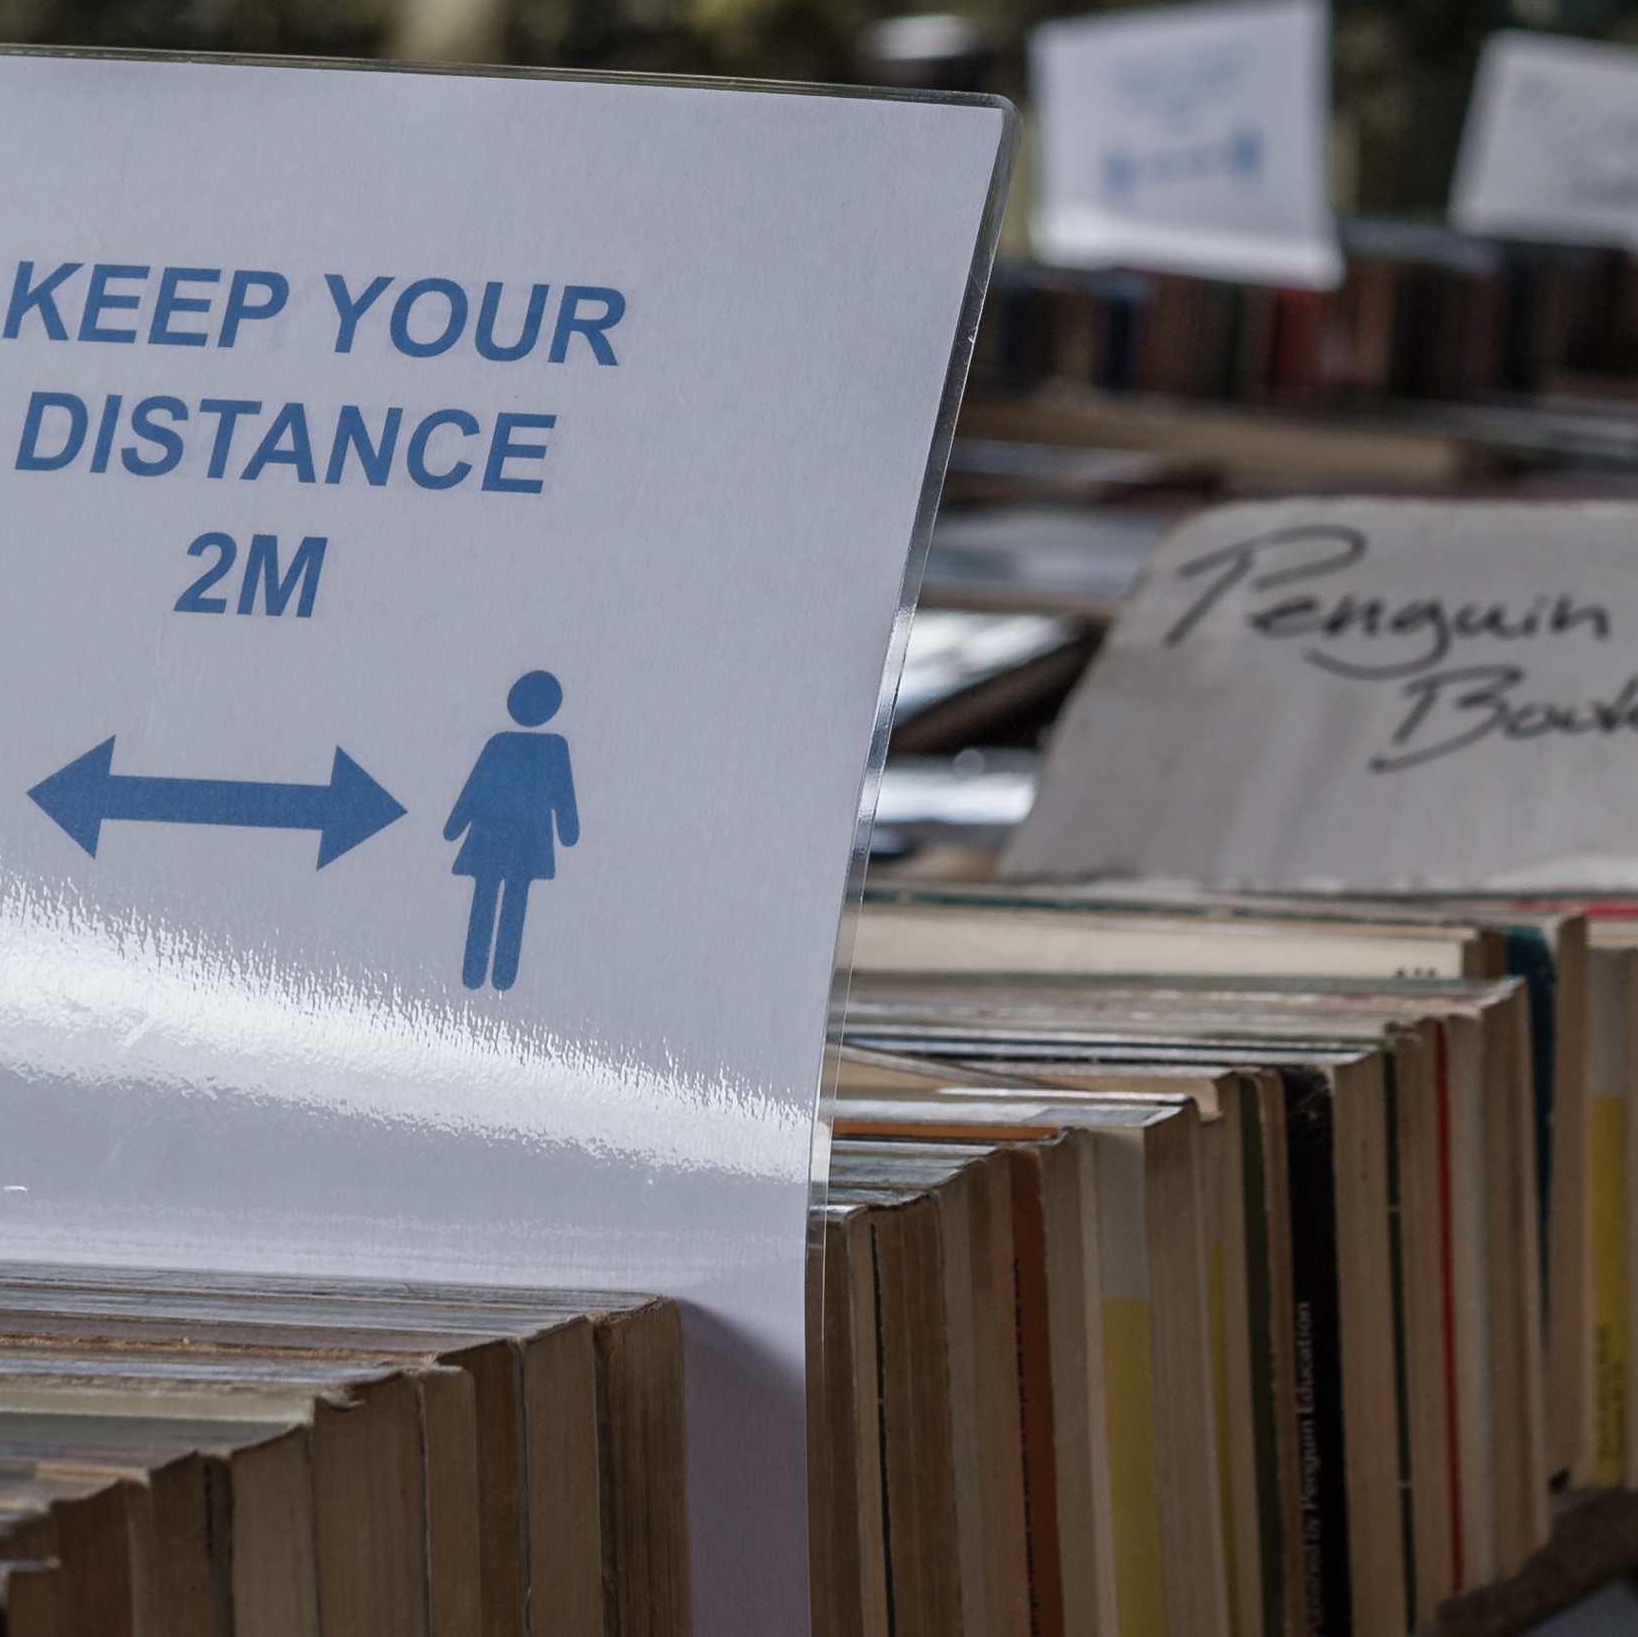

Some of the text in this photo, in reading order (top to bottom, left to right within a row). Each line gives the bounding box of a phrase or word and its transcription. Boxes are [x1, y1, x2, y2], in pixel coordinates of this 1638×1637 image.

[2, 260, 626, 366] KEEP YOUR
[15, 391, 557, 494] DISTANCE
[173, 532, 328, 618] 2M
[1167, 522, 1611, 680] Penguin
[1296, 1301, 1315, 1414] Education
[1300, 1418, 1320, 1510] Penguin
